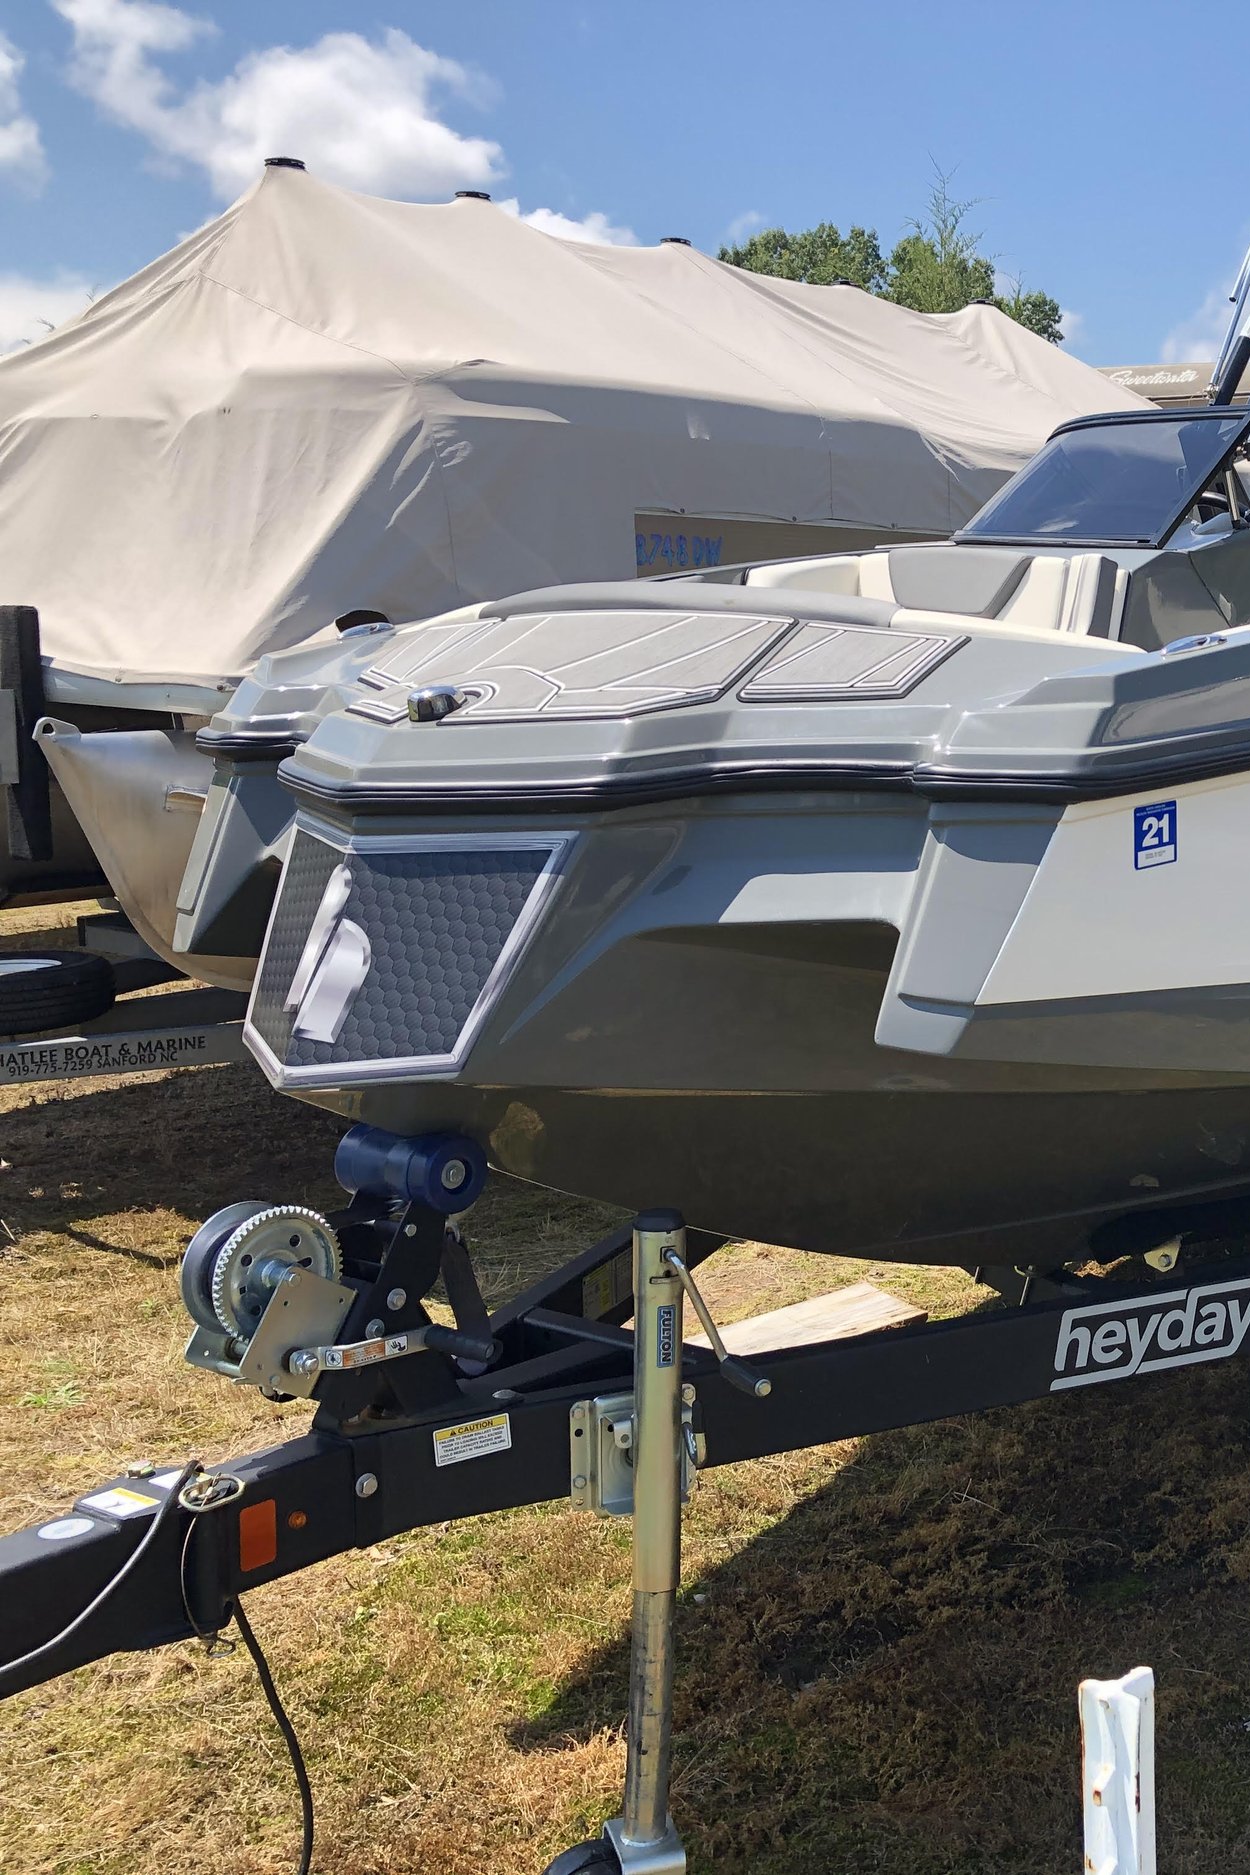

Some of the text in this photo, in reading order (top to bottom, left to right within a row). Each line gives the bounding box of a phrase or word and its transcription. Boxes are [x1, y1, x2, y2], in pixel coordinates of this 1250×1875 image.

[1142, 813, 1170, 848] 21
[64, 1044, 112, 1061] BOAT
[118, 1043, 131, 1055] &
[137, 1036, 206, 1054] MARINE
[8, 1050, 178, 1077] 919-775-7259 SANFORD NC
[661, 1308, 673, 1363] FULTON
[458, 1420, 493, 1434] CAUTION
